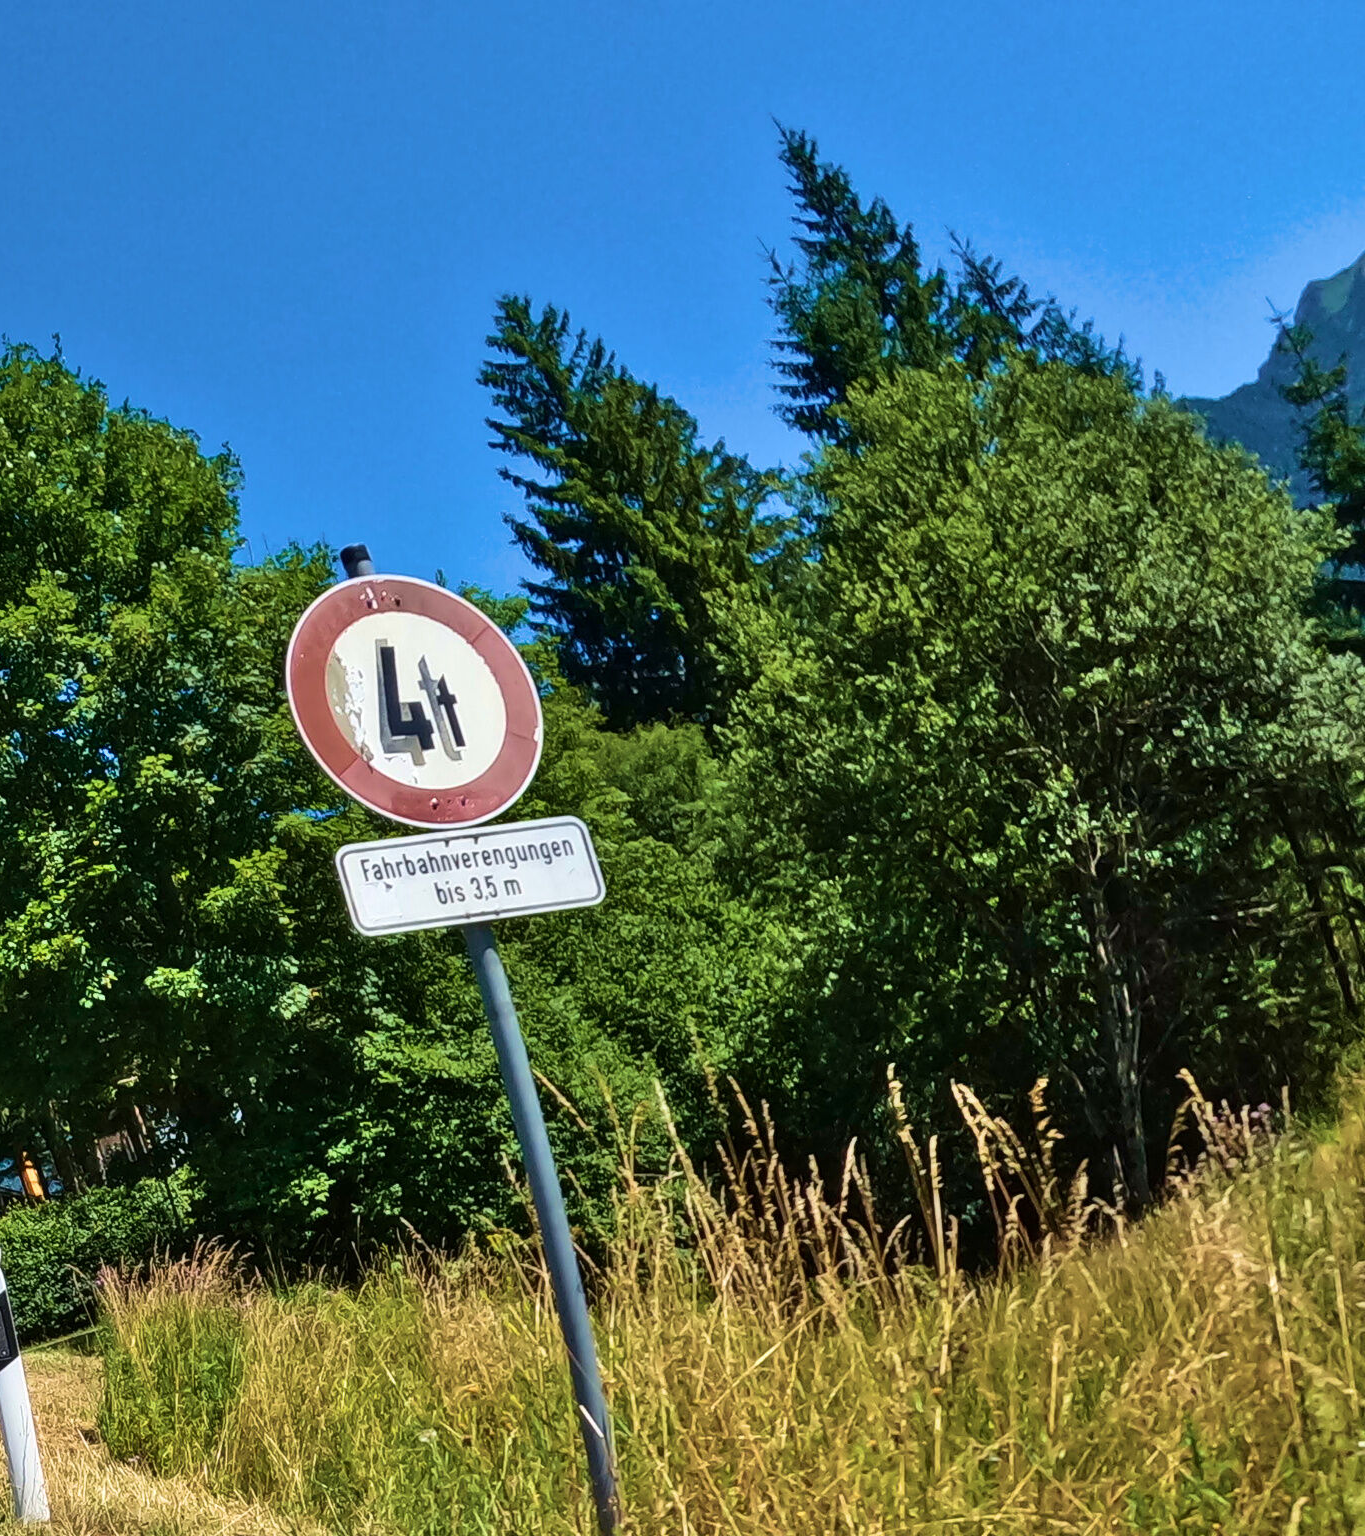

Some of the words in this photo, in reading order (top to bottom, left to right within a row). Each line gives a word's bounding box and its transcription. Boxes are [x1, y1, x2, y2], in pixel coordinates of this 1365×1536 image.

[359, 838, 574, 882] Fahrbahnverengungen
[434, 881, 466, 905] bis
[469, 874, 498, 901] 3,5
[503, 877, 522, 897] m
